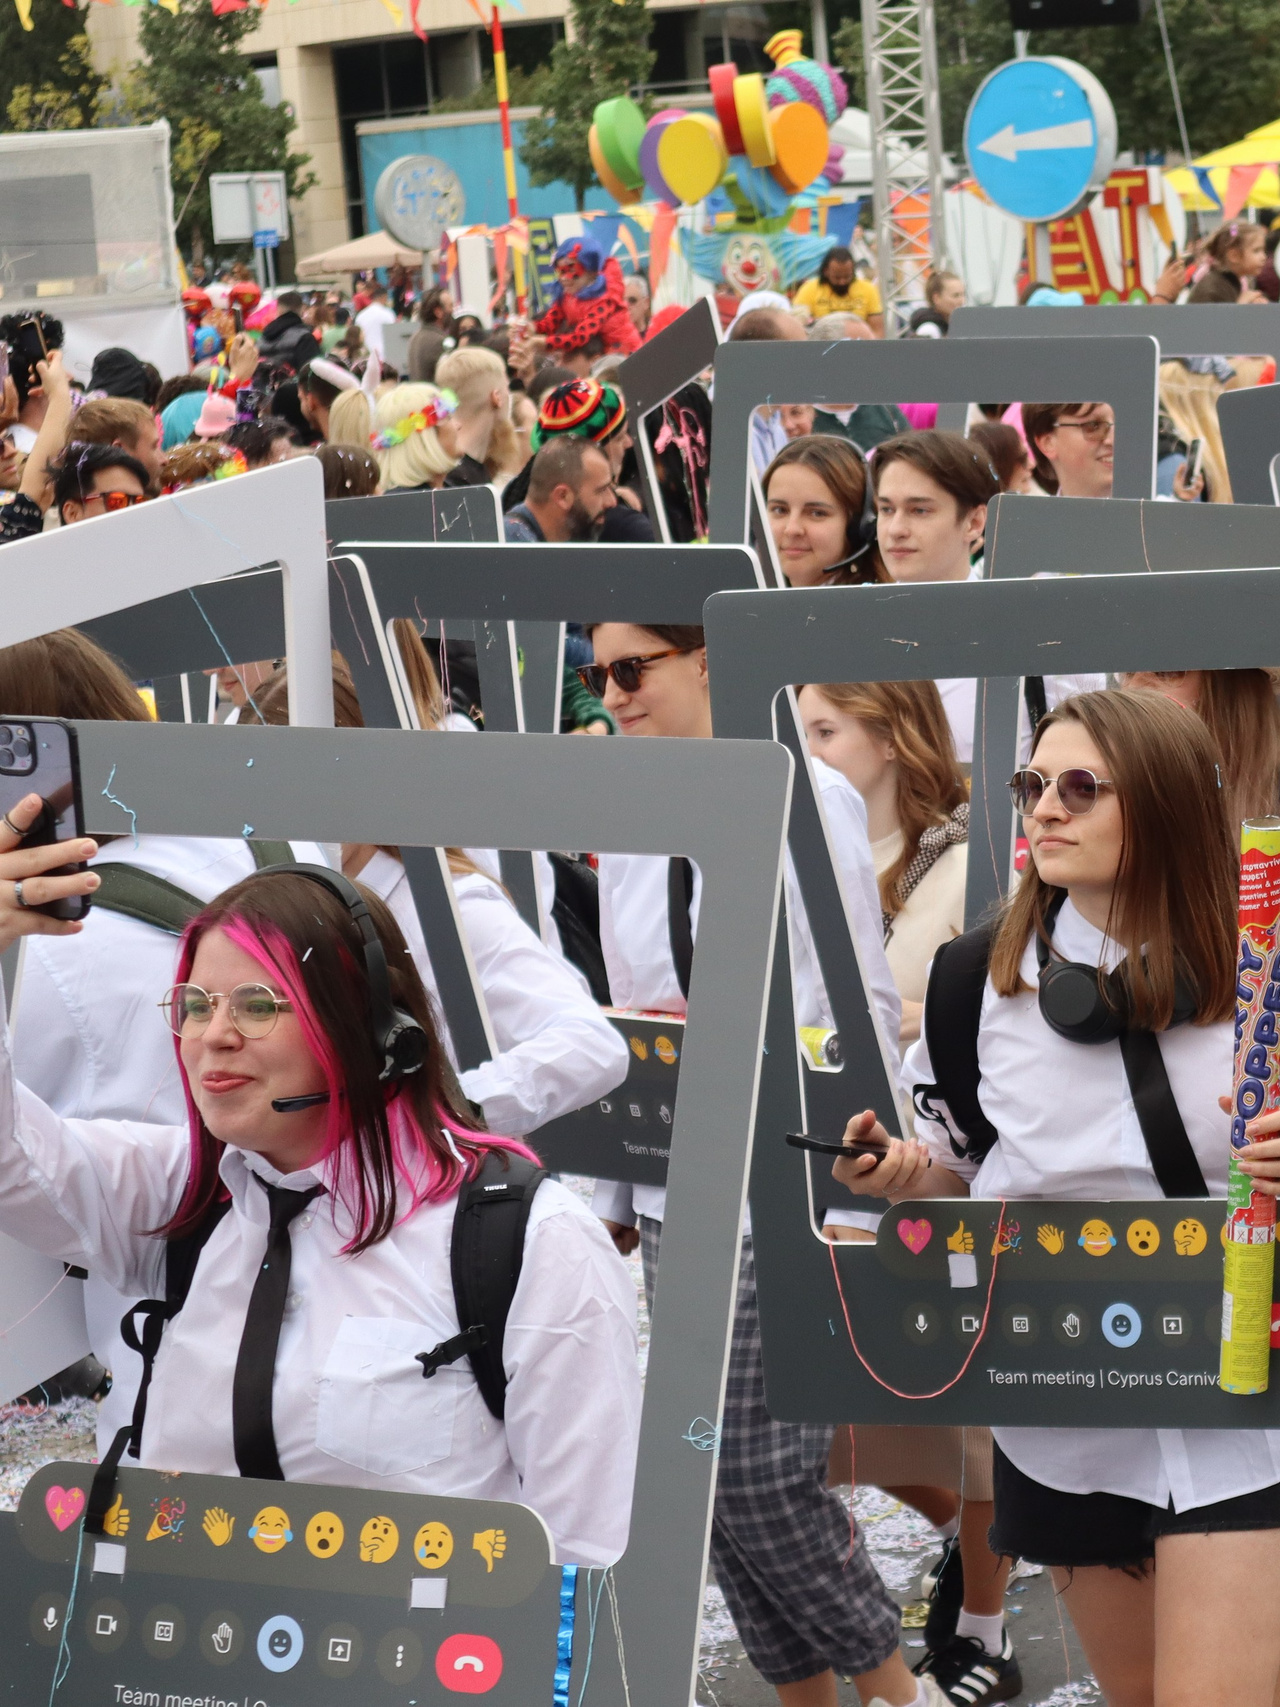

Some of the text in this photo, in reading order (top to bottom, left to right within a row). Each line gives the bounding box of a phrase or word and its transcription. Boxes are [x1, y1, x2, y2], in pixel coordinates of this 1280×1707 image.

[622, 1141, 649, 1156] Team
[483, 1183, 508, 1192] THULE
[986, 1369, 1028, 1385] Team
[1032, 1369, 1095, 1389] meeting
[1107, 1370, 1163, 1389] Cyprus
[1166, 1371, 1220, 1387] Carniv
[114, 1684, 160, 1707] Team
